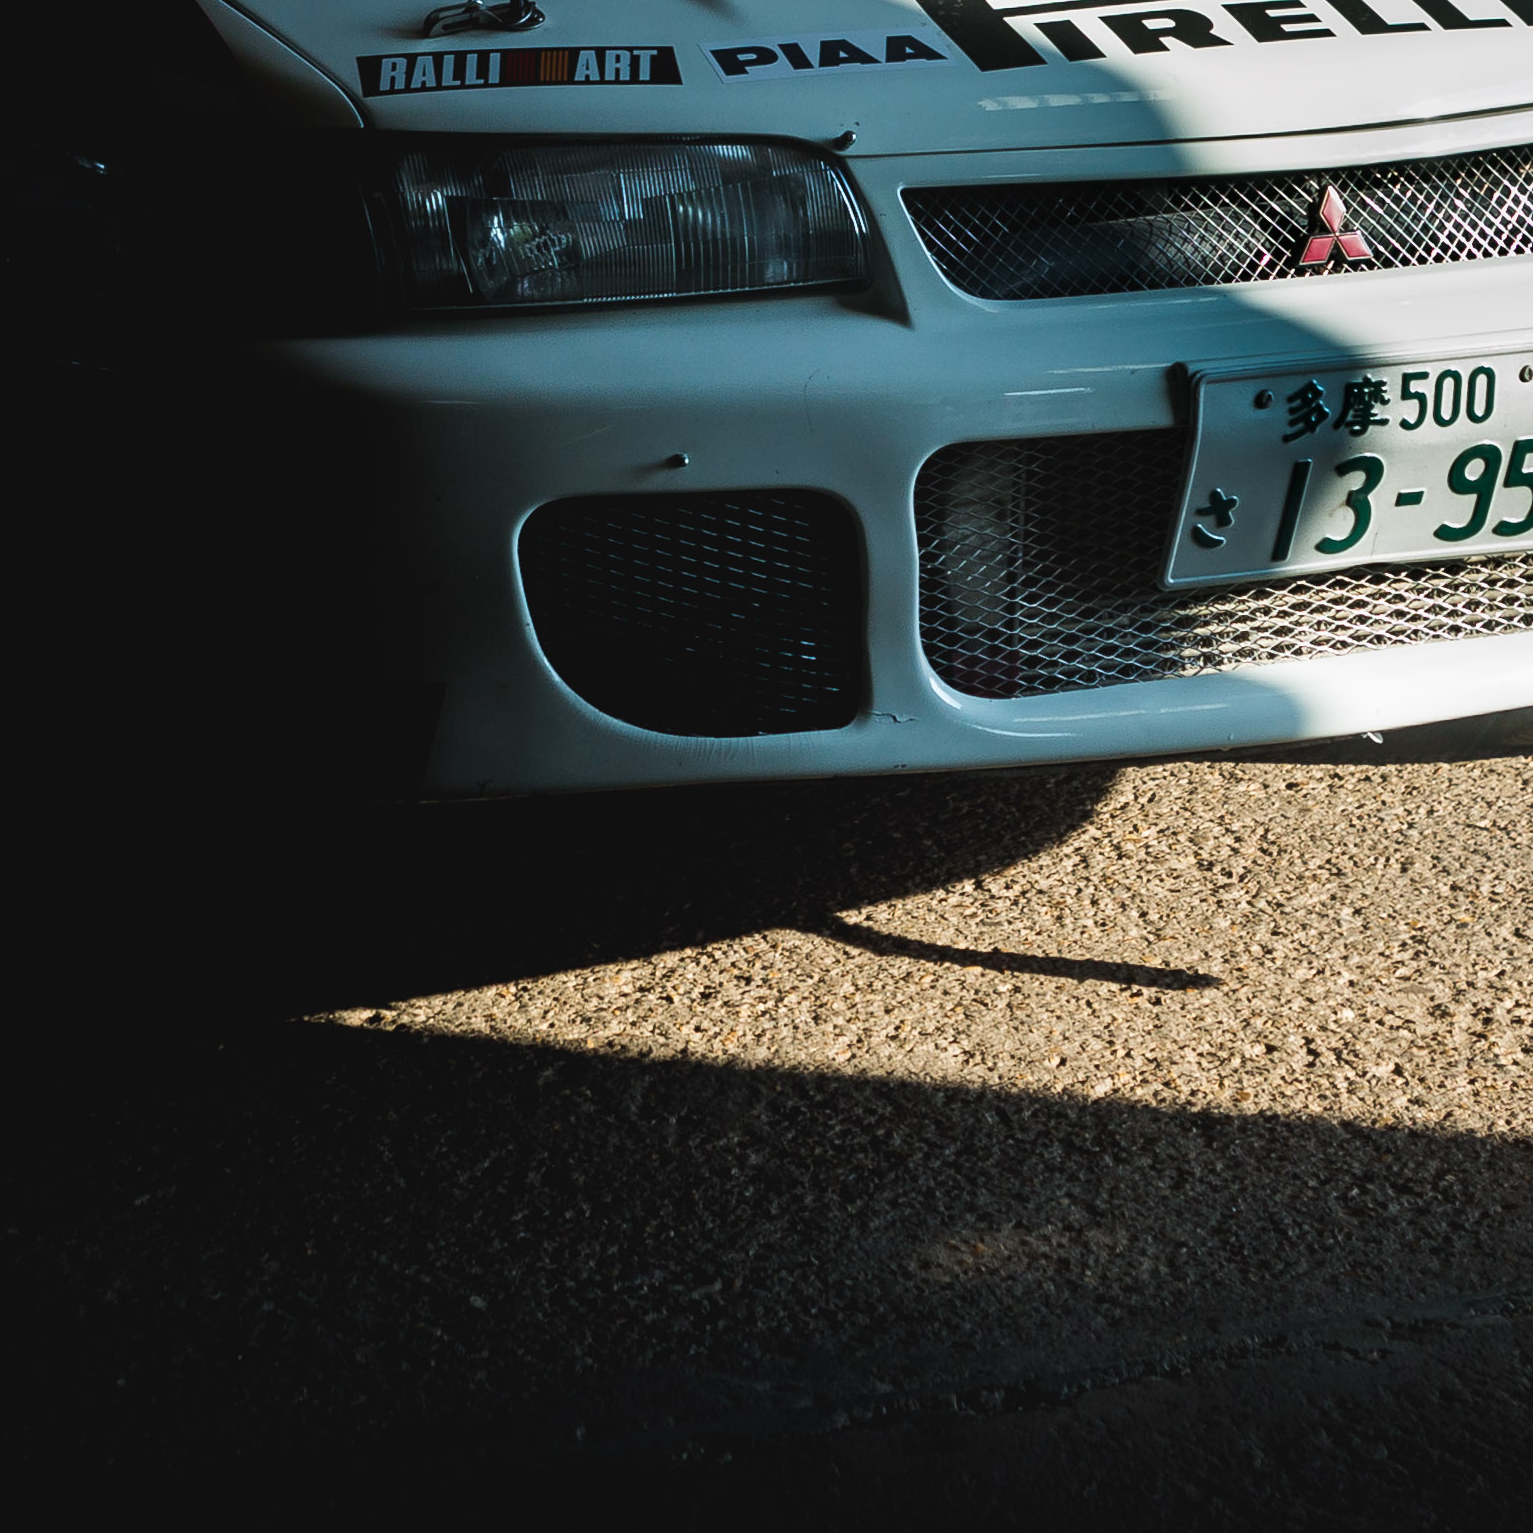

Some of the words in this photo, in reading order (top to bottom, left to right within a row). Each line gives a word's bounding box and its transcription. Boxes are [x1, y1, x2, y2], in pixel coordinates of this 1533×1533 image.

[379, 52, 501, 91] RALLI
[574, 49, 658, 82] ART
[709, 35, 948, 76] PIAA
[1192, 488, 1239, 548] さ
